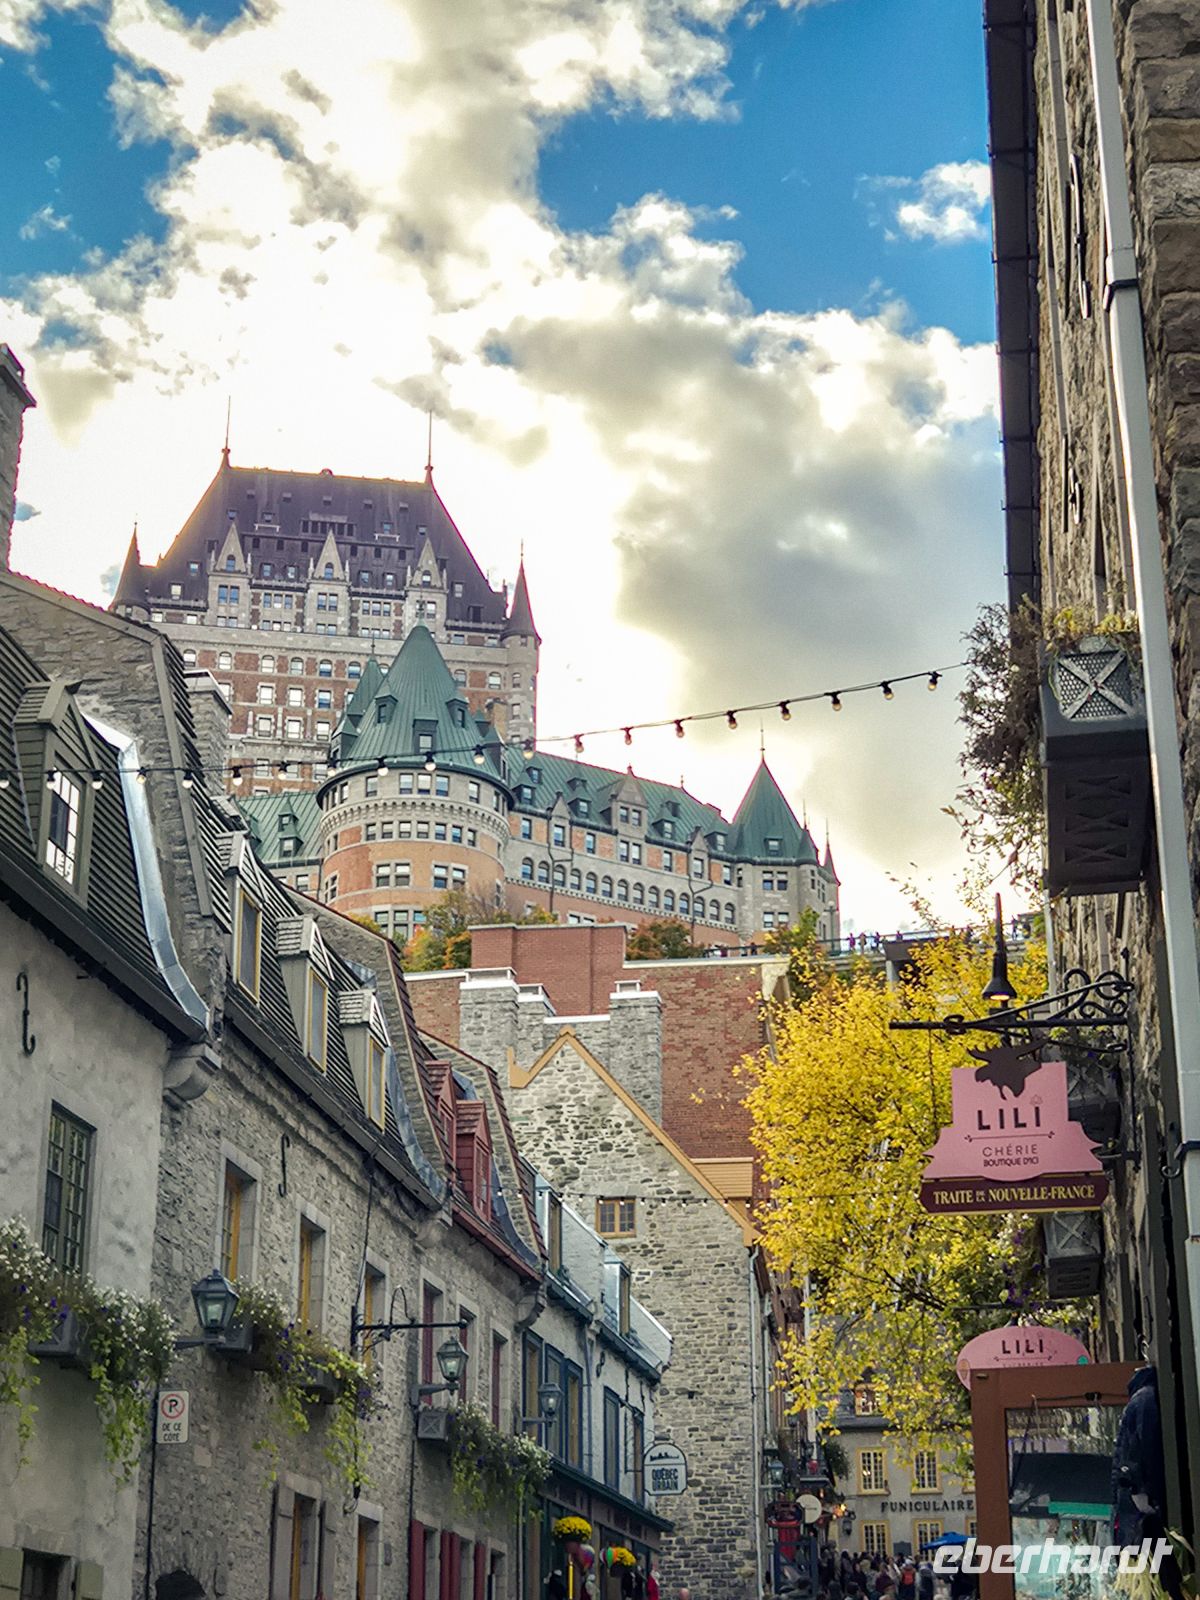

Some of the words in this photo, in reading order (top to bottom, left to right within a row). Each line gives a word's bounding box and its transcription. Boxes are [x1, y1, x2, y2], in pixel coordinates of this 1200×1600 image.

[977, 1106, 1041, 1130] LILI
[982, 1143, 1038, 1157] CHÉRIE
[983, 1158, 1021, 1167] BOUTIQUE
[933, 1189, 974, 1204] TRAITE
[1002, 1339, 1044, 1354] LILI
[651, 1467, 679, 1480] QUÉBEC
[881, 1499, 974, 1513] FUNICULAIRE
